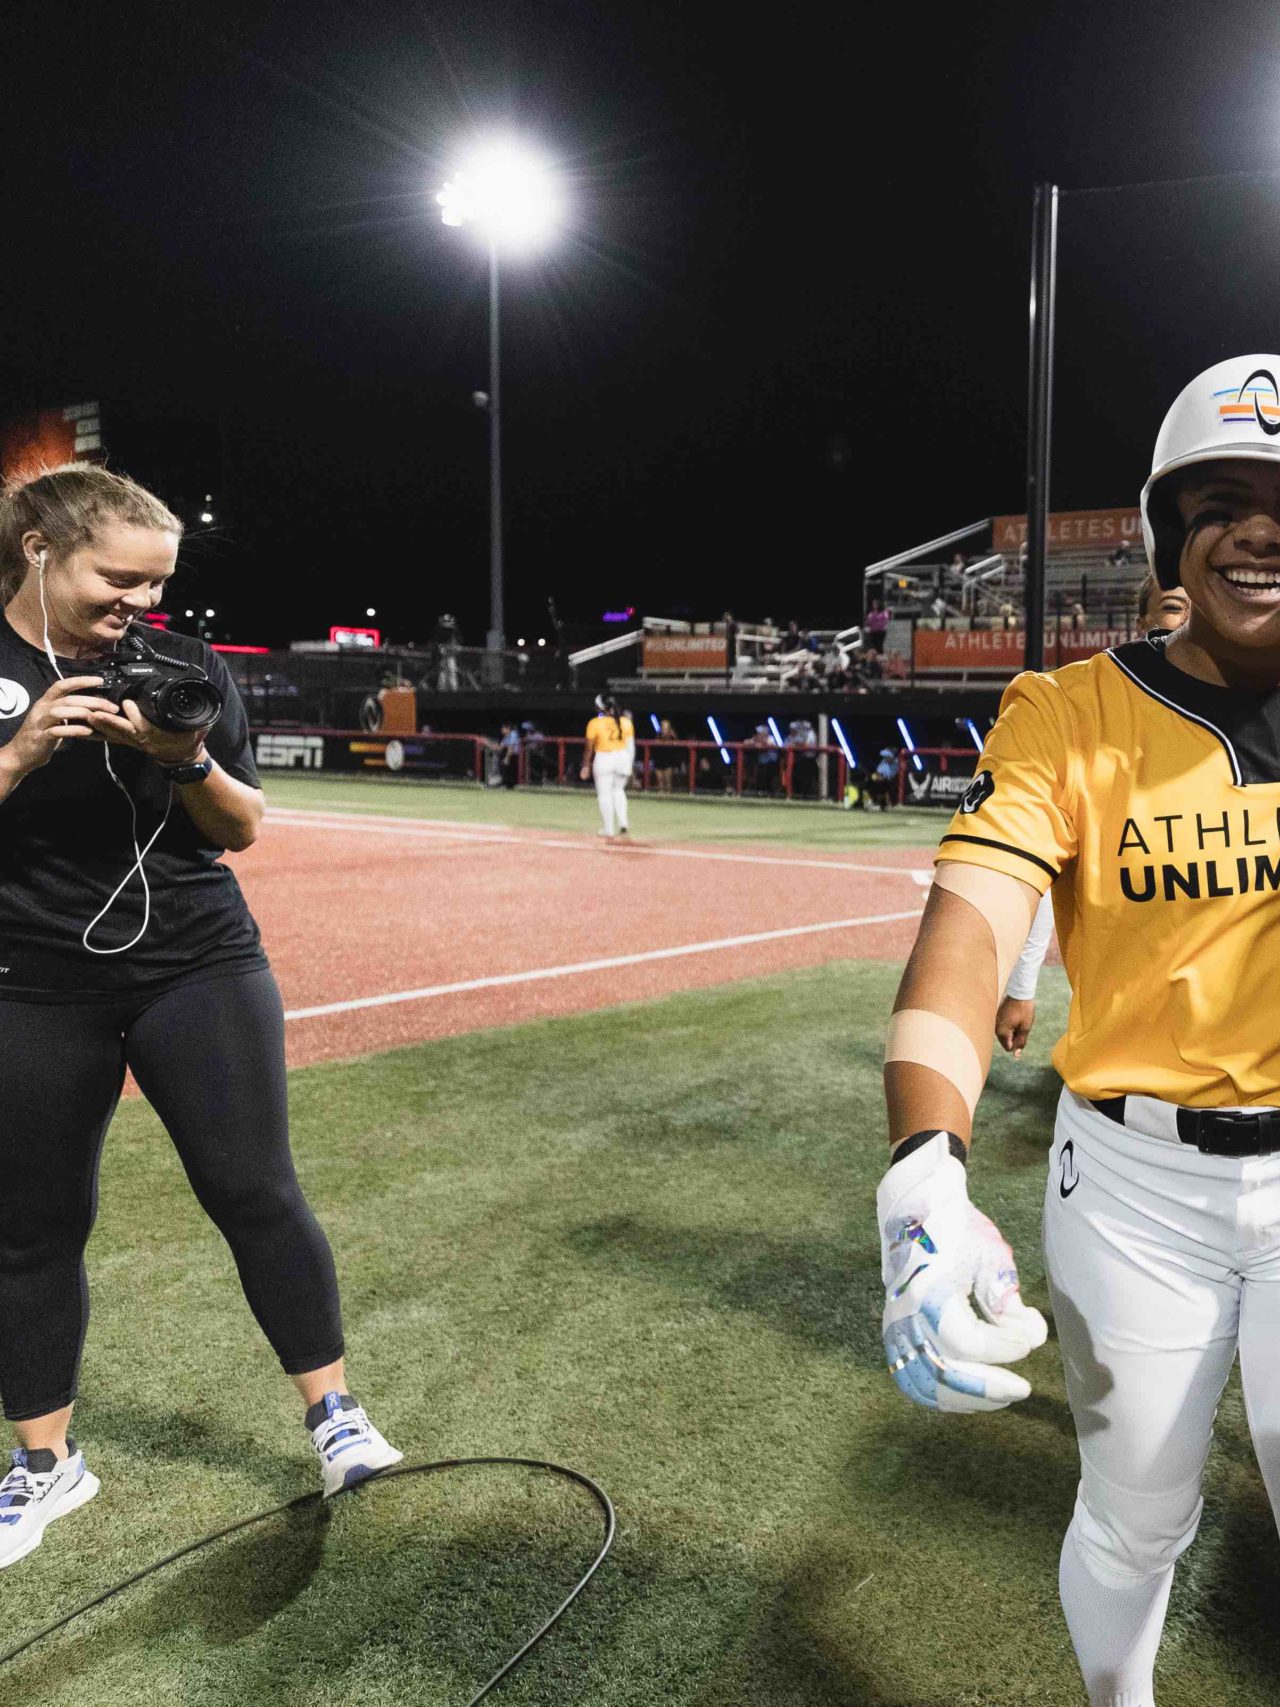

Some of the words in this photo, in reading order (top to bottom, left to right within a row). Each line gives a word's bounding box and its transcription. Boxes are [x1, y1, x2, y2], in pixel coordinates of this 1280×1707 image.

[1004, 517, 1115, 542] ATLETES
[945, 631, 1026, 649] ATHLETE
[1043, 631, 1138, 649] UNLIMITE
[256, 734, 324, 768] ESPN
